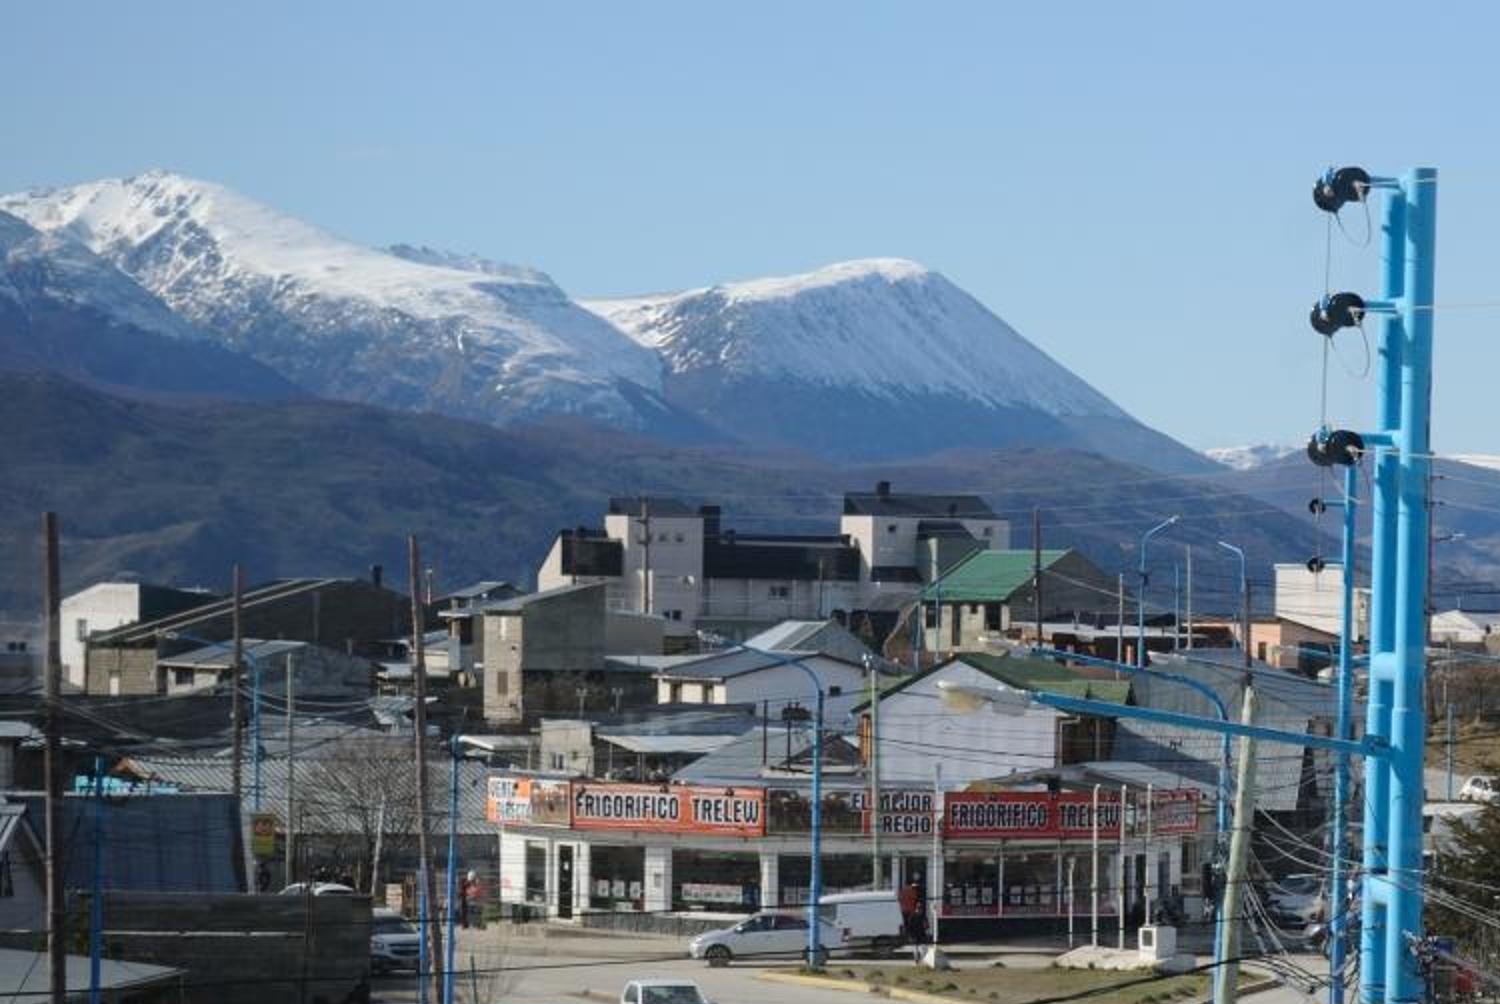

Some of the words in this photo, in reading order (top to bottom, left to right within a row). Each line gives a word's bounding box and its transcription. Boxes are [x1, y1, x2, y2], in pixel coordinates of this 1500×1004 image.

[575, 794, 680, 820] FRIGORIFICO
[692, 798, 760, 823] TRELEW
[951, 803, 1047, 827] FRIGORIFICO
[1059, 804, 1121, 828] TRELEW
[881, 815, 931, 833] RECIO
